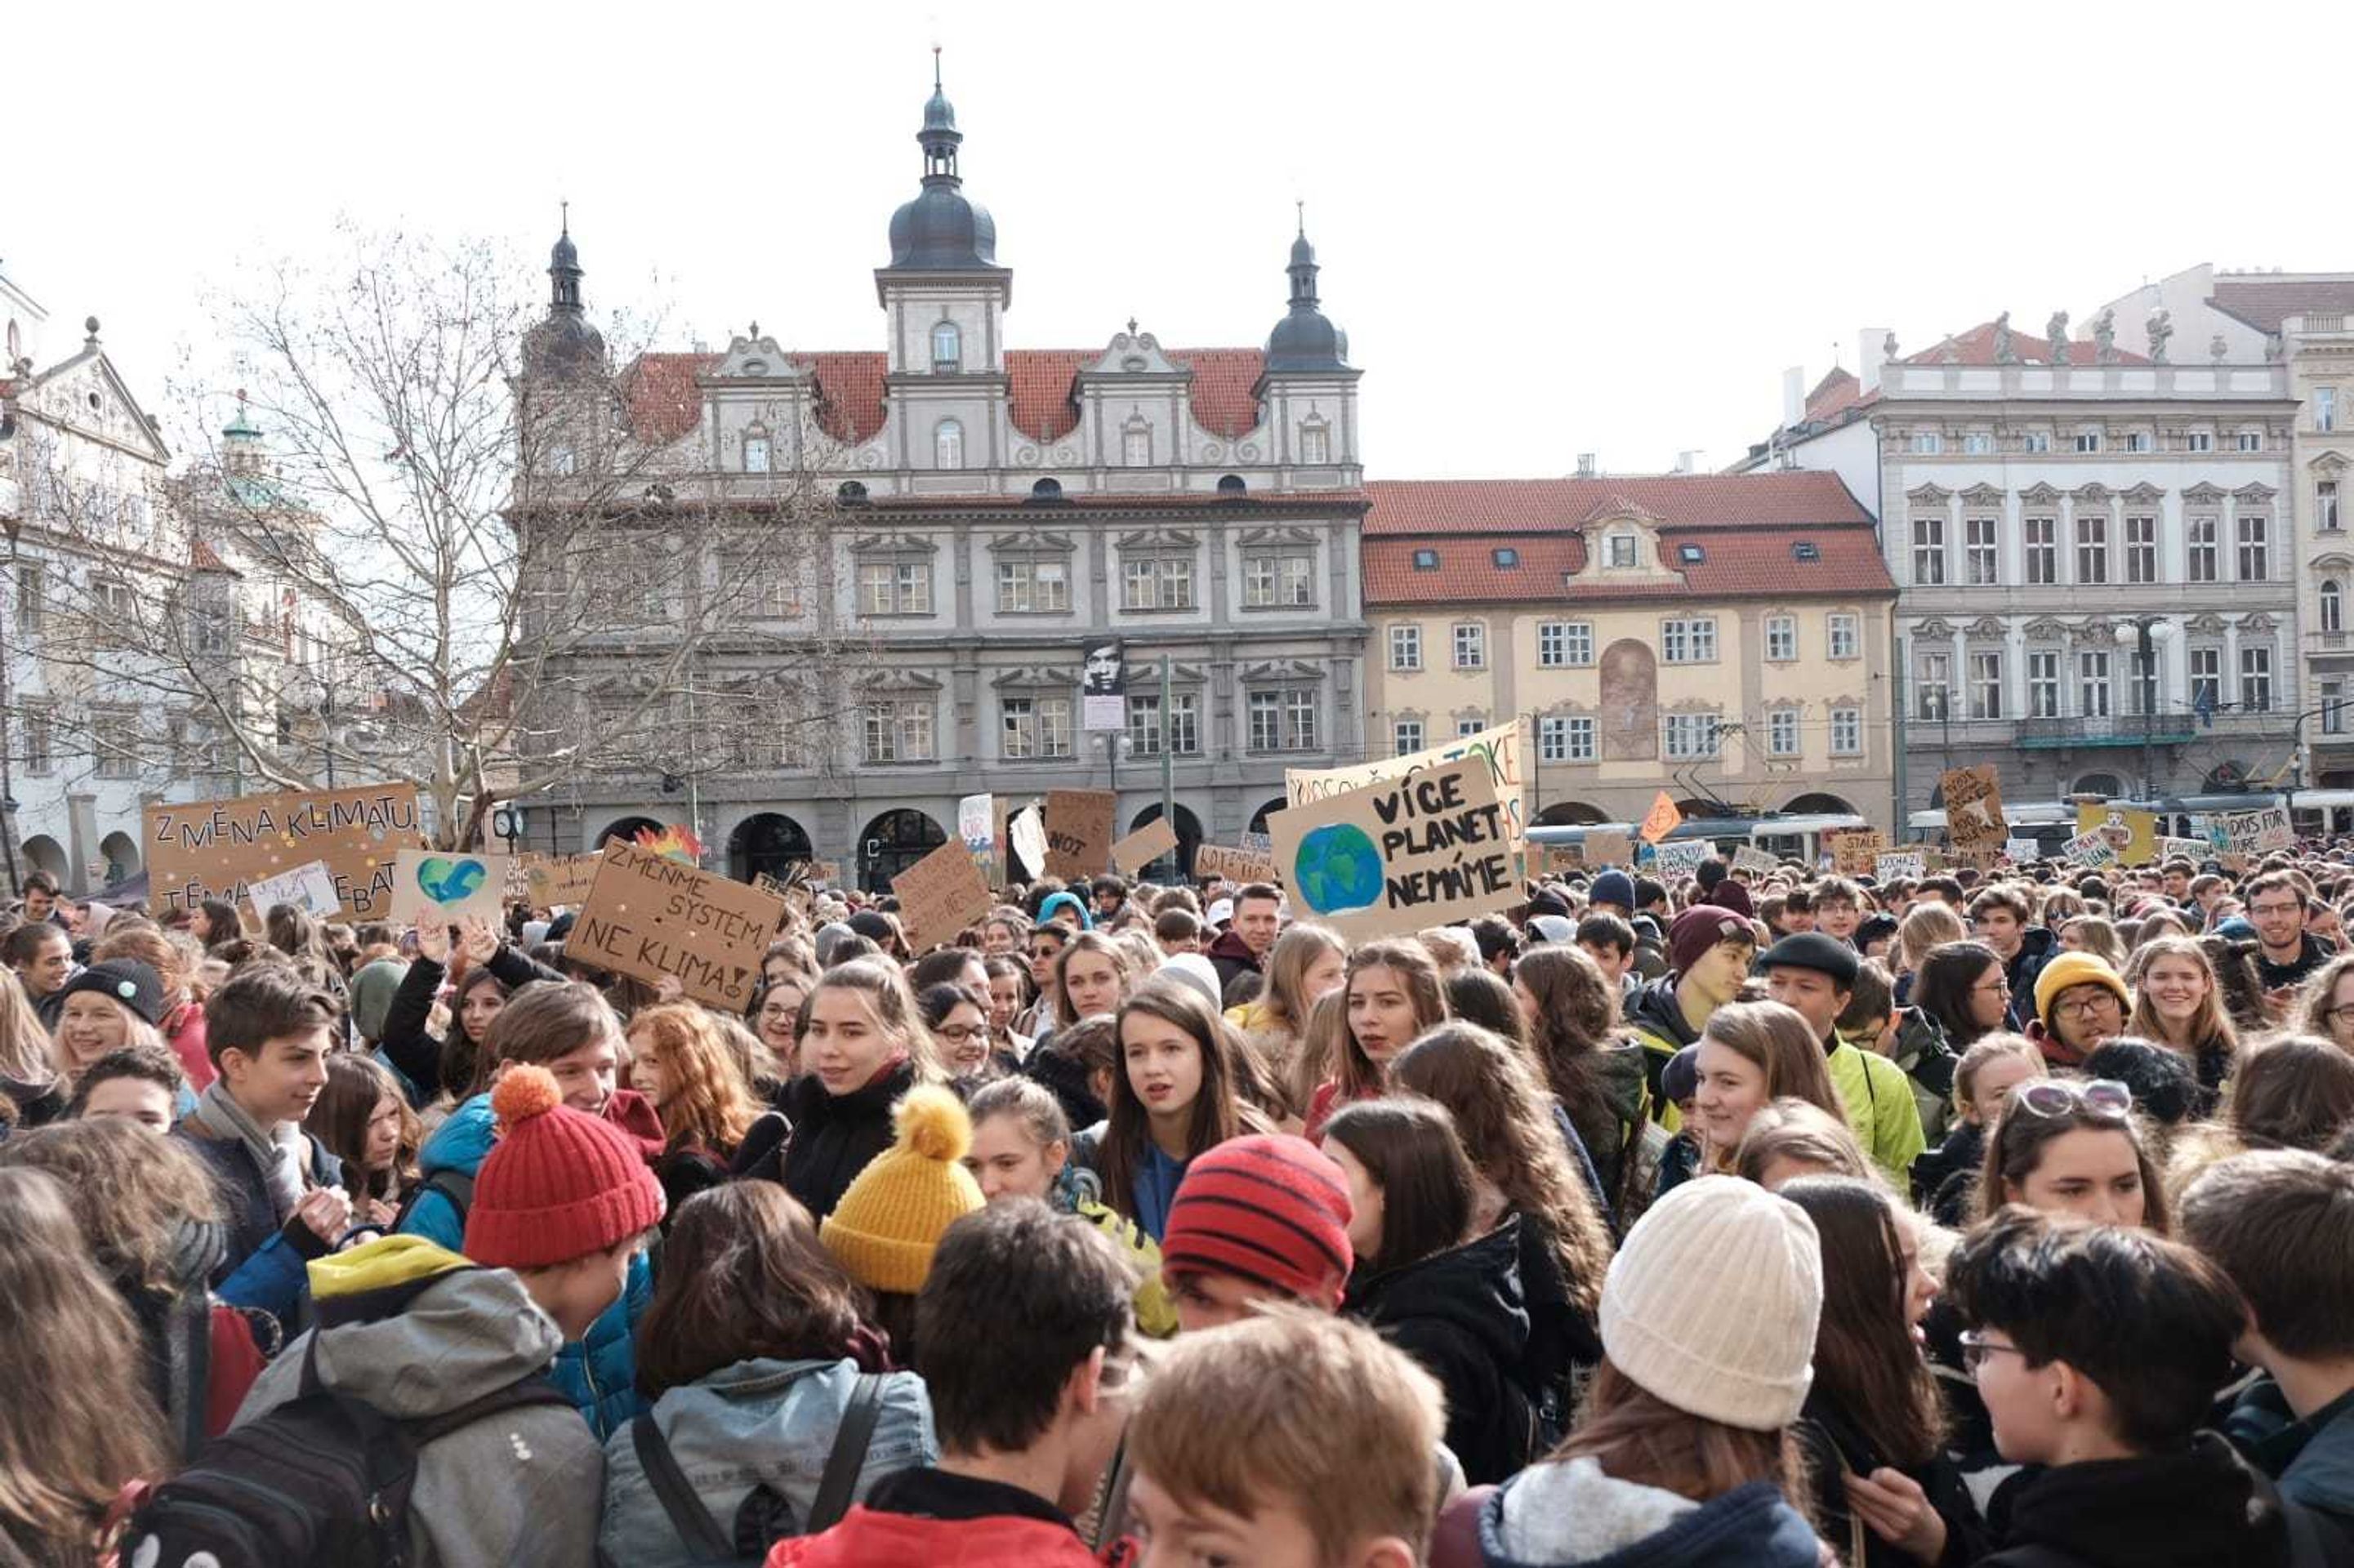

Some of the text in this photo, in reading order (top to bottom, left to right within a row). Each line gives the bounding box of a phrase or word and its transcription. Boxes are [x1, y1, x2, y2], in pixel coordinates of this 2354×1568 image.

[156, 796, 417, 849] ZMĚNA KLIMATU,
[1372, 773, 1465, 825] VÍCE
[2262, 810, 2285, 830] FOR
[1050, 831, 1086, 856] NOT
[1382, 804, 1500, 861] PLANET
[328, 862, 395, 914] EBAT
[1387, 851, 1512, 908] NEMÁME
[582, 919, 750, 998] NE KLIMA!
